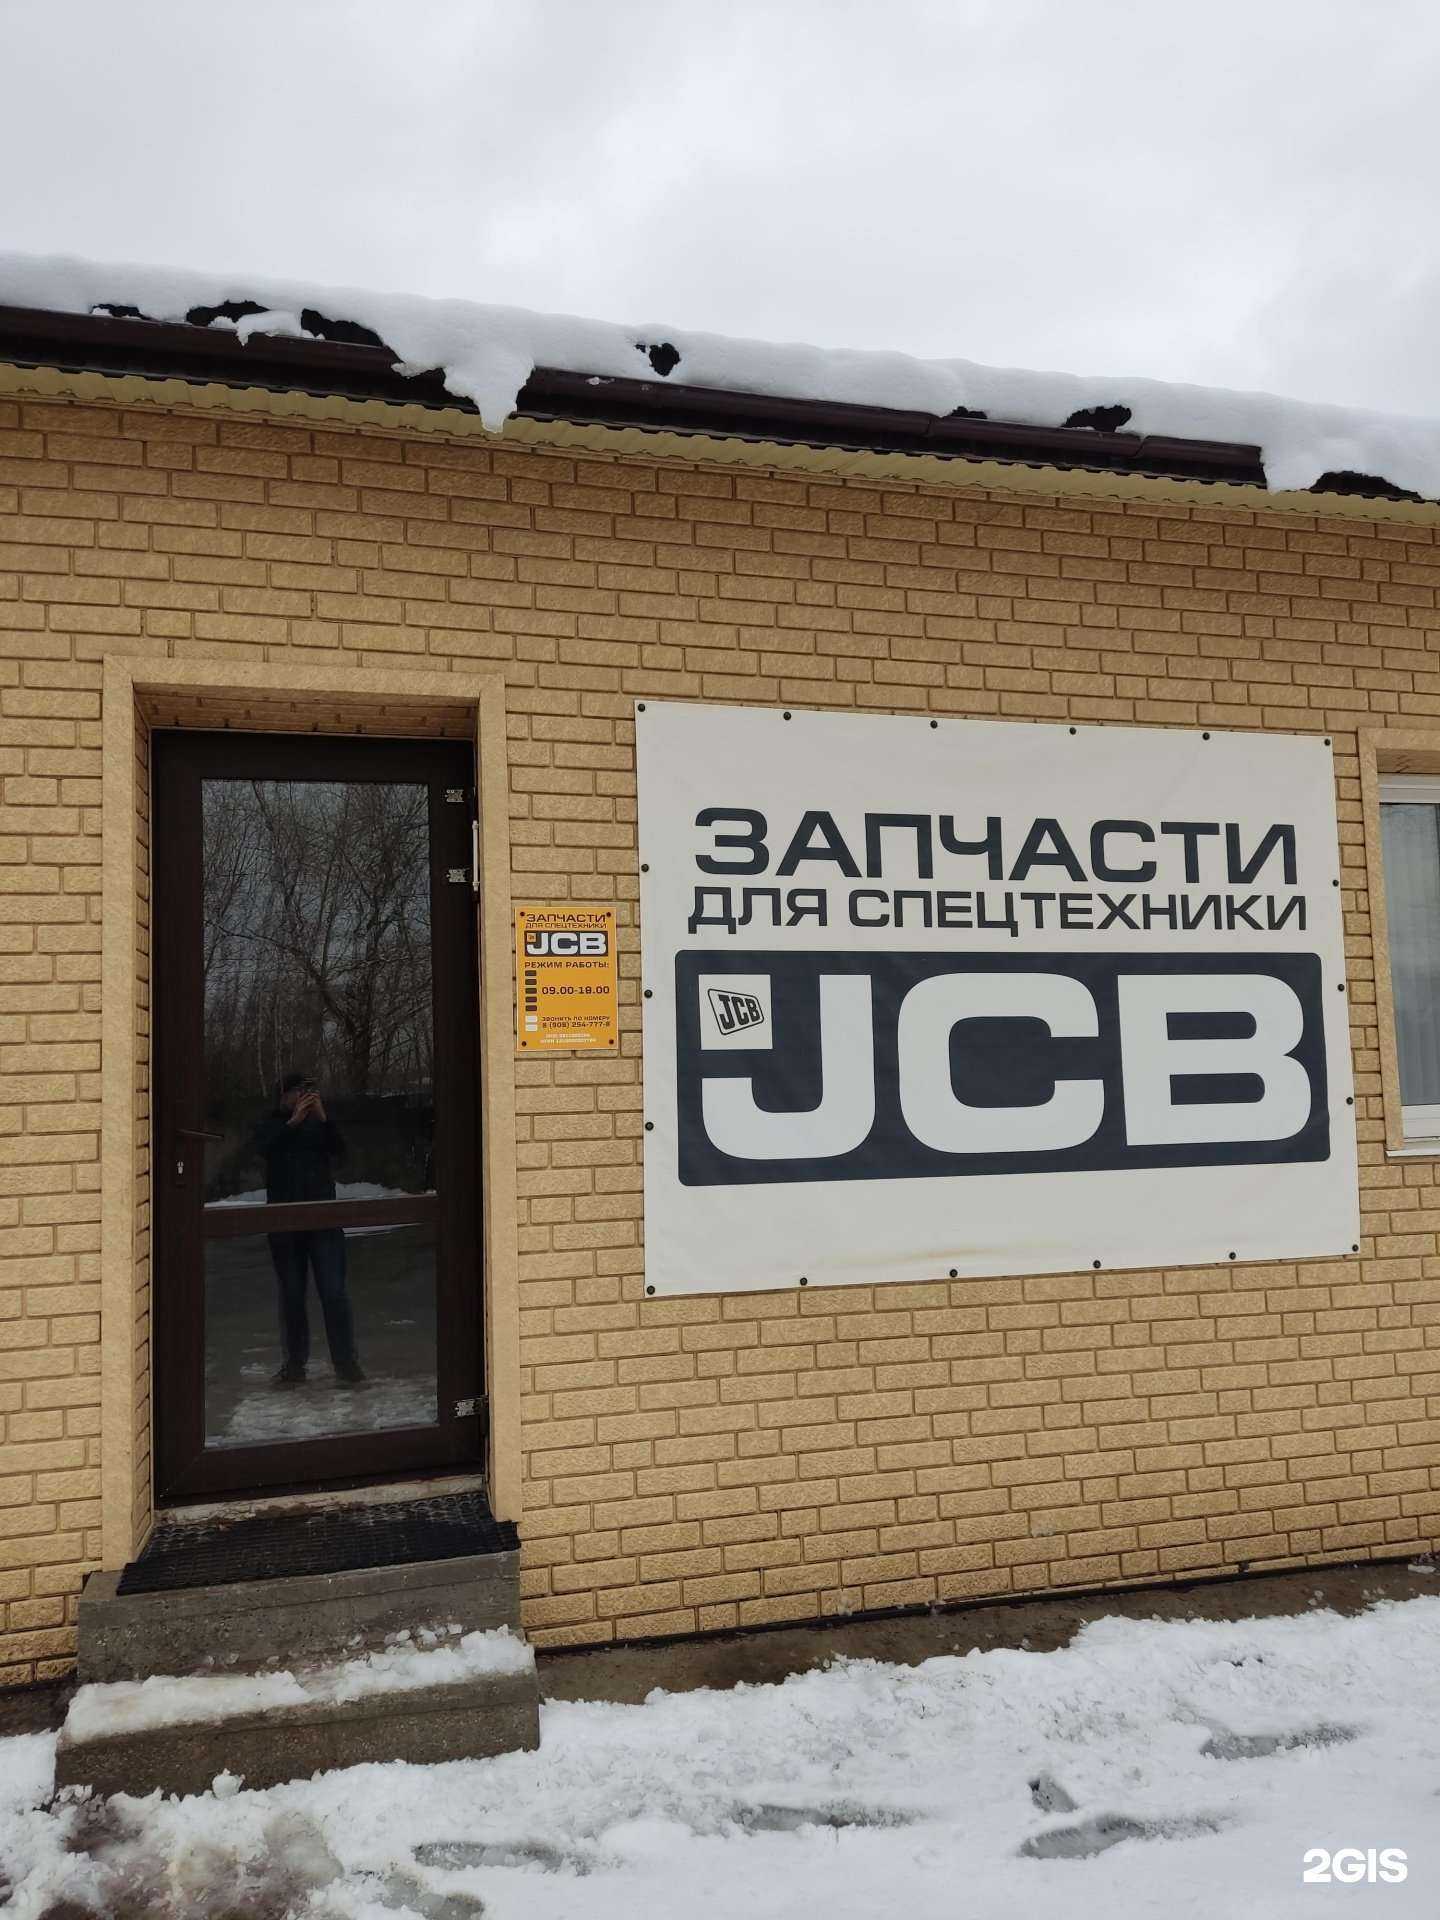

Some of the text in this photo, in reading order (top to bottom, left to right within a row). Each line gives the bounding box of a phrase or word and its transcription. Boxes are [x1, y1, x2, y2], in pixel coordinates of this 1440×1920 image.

[695, 807, 1298, 885] ЗАПЧАСТИ
[526, 913, 606, 923] ЗАПЧАСТИ
[688, 886, 1307, 937] ДЛЯ СПЕЦТЕХНИКИ
[526, 932, 607, 955] JCB
[524, 961, 609, 969] РЕЖИМ РАБОТЫ:
[541, 985, 610, 995] 09.00-18.00
[717, 993, 761, 1031] JCB
[701, 972, 1312, 1161] JCB
